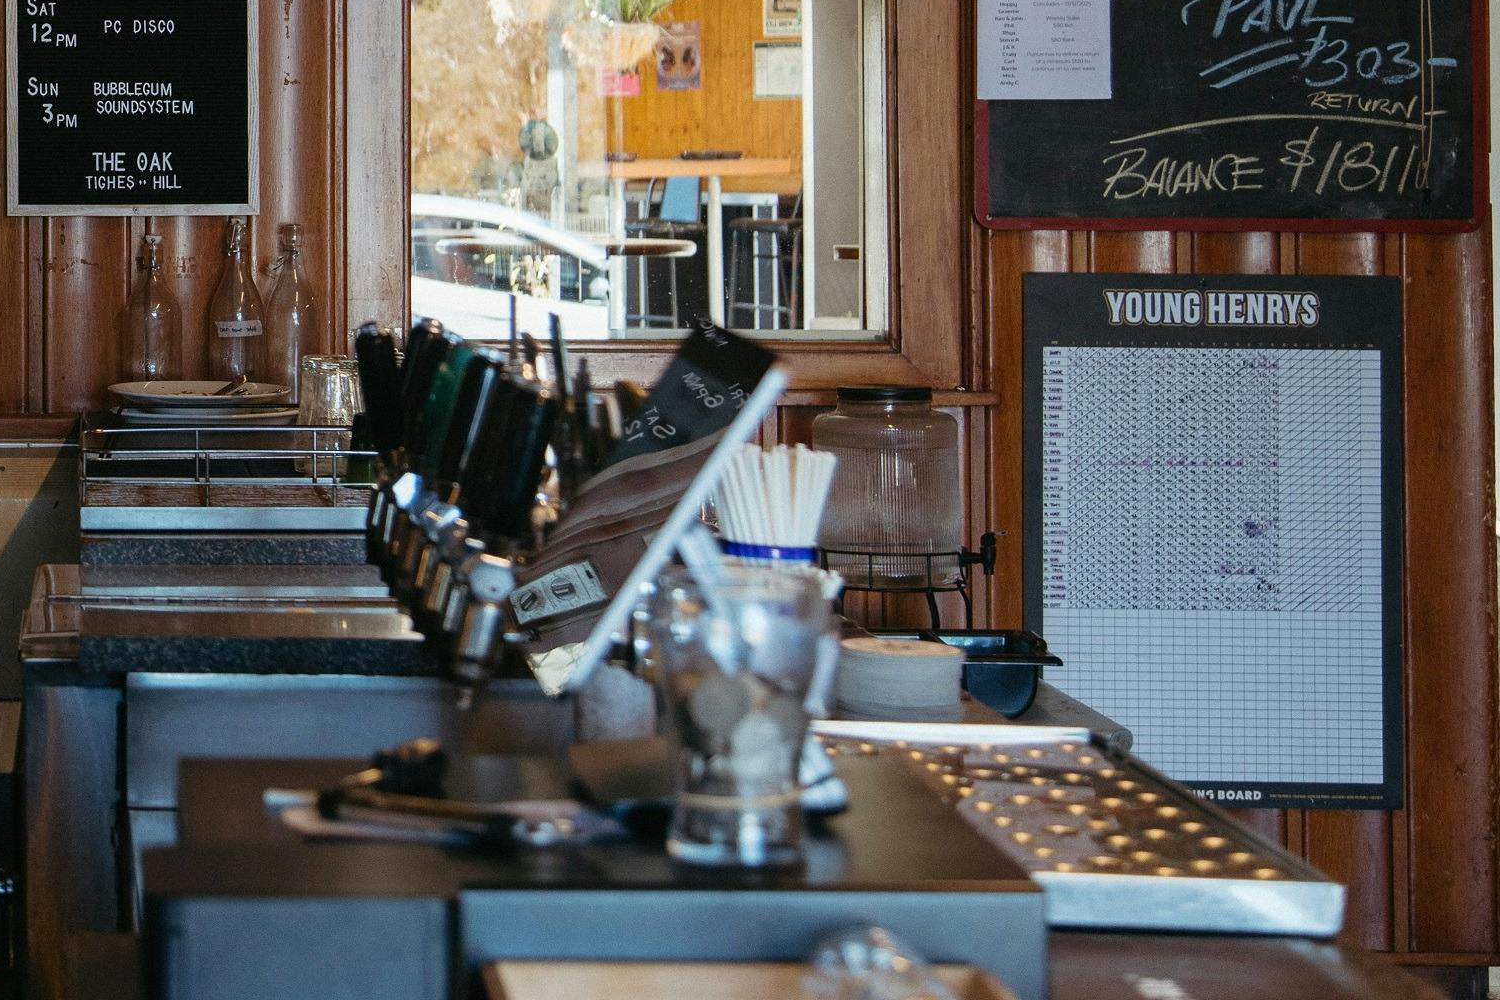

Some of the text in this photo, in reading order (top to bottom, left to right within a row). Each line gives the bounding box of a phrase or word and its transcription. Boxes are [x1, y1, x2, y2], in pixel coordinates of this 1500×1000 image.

[104, 19, 122, 34] PC
[133, 19, 175, 34] DISCO
[27, 76, 173, 97] SUN BUBBLEGUM
[96, 99, 195, 115] SOUNDSYSTEM
[1306, 90, 1419, 120] RETURN
[92, 152, 173, 172] THE OAK
[85, 174, 182, 190] TIGHES HILL
[1103, 147, 1264, 200] BALANCE
[1105, 290, 1320, 327] YOUNG HENRYS
[1217, 790, 1262, 801] BOARD
